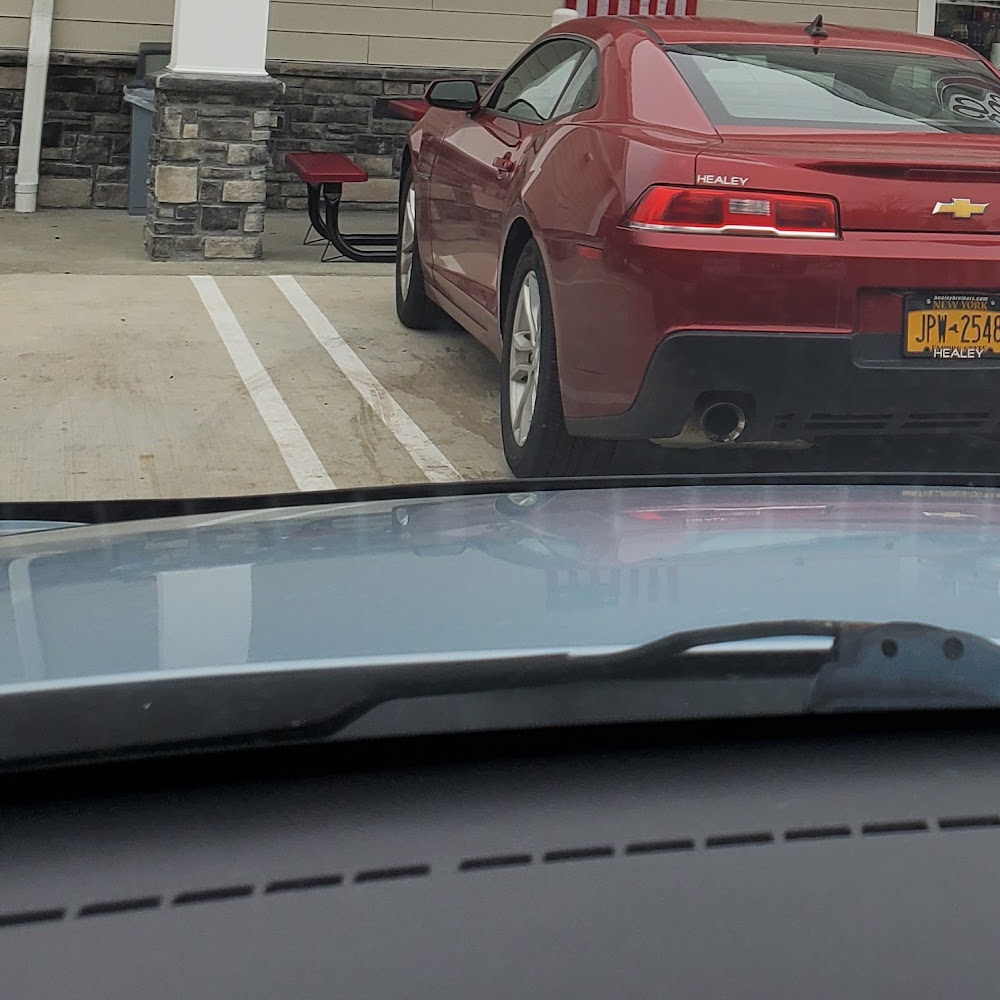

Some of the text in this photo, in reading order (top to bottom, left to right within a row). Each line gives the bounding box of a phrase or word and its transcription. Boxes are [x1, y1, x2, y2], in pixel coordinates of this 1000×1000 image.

[697, 174, 749, 186] HEALEY
[932, 300, 988, 310] NEW YORK
[933, 348, 984, 359] HEALEY
